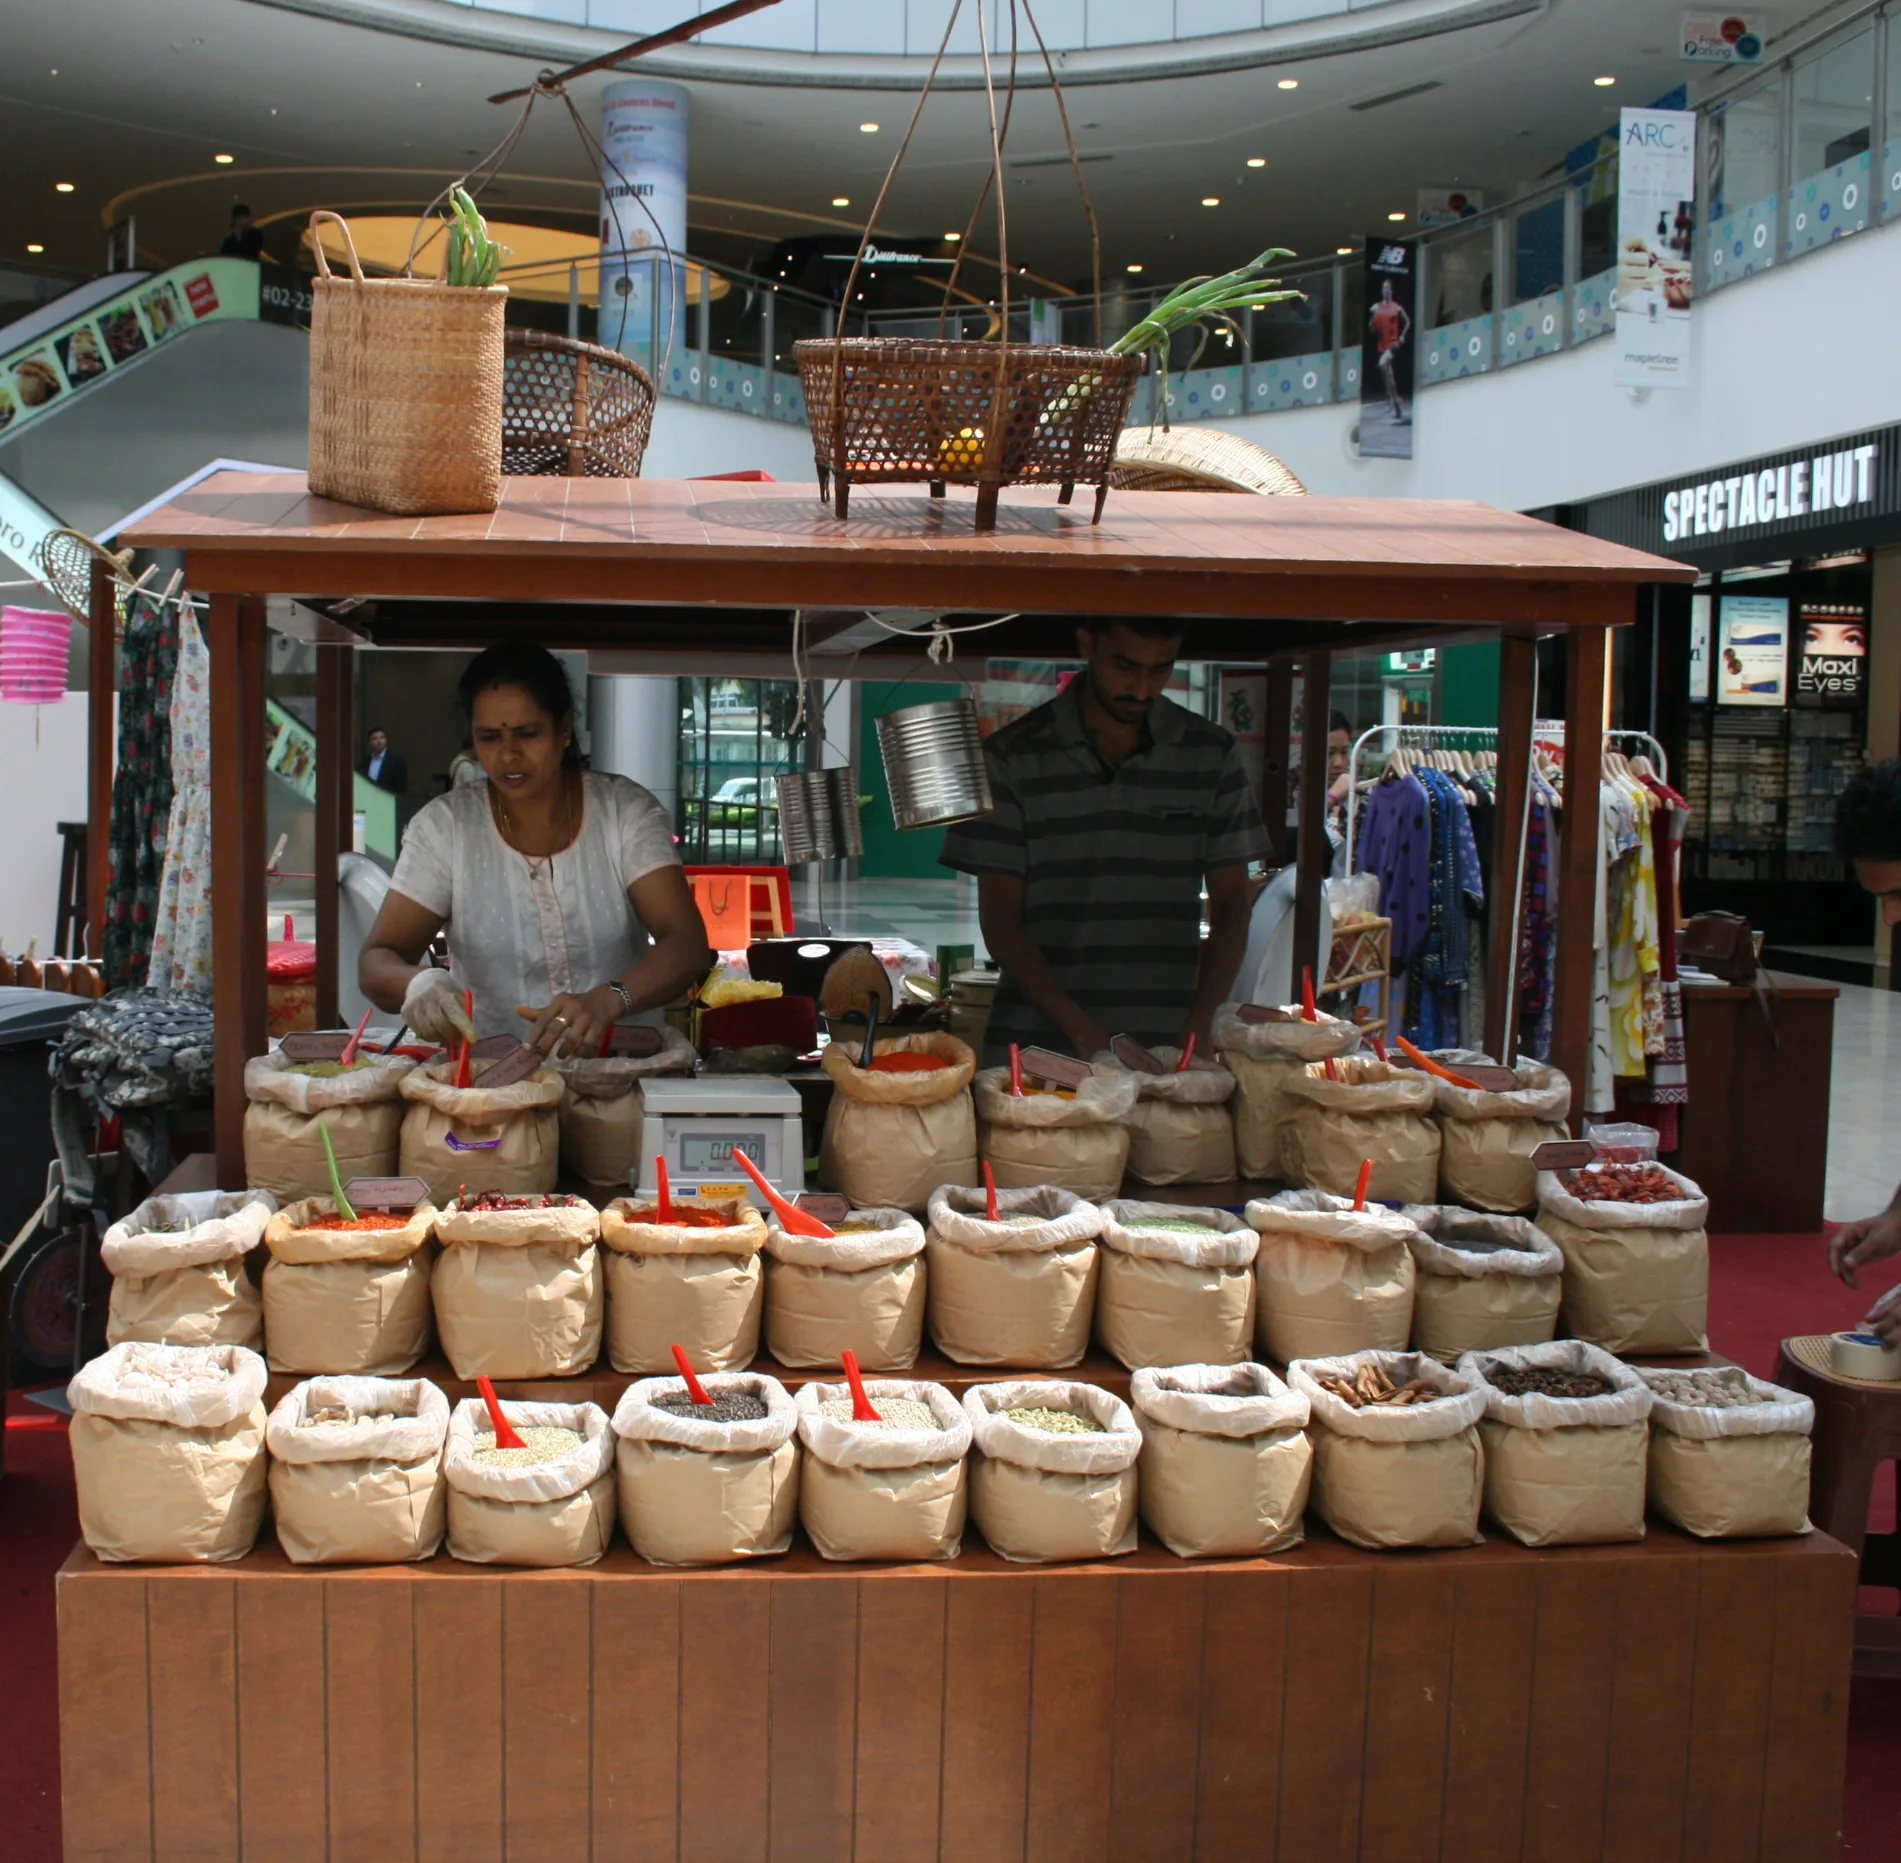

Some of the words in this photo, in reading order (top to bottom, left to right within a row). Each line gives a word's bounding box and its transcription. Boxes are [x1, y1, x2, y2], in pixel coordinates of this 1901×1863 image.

[1663, 460, 1808, 541] SPECTACLE
[1812, 443, 1877, 512] HUT
[1802, 656, 1857, 675] Maxi
[1798, 673, 1857, 694] Eyes
